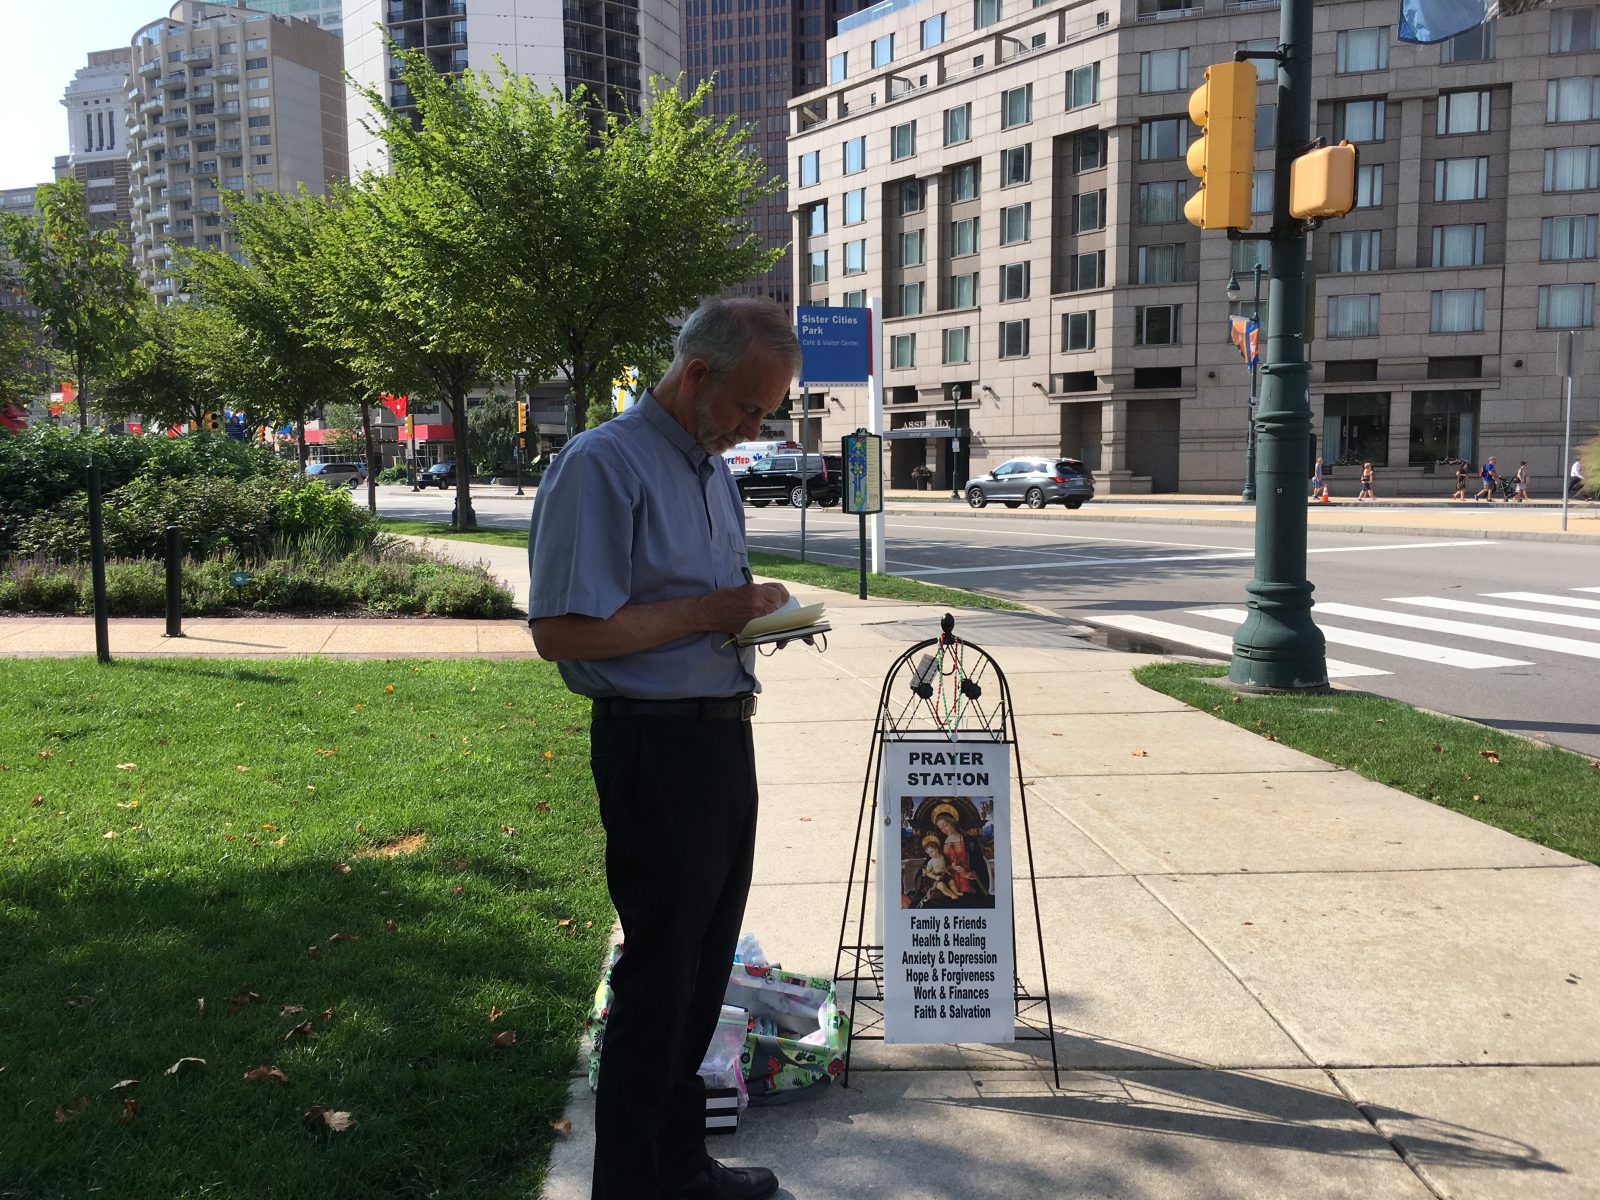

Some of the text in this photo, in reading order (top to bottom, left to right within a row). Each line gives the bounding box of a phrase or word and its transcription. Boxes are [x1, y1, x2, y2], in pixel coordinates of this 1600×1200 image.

[802, 315, 858, 324] Sister Cities
[802, 326, 823, 334] Park
[903, 419, 951, 429] ASSEBLY
[909, 752, 984, 766] PRAYER
[907, 772, 989, 786] STATION
[910, 916, 987, 932] Family & Friends
[912, 933, 986, 950] Health & Healing
[902, 951, 998, 967] Anxiety & Depression
[906, 968, 995, 985] Hope & Forgiveness
[914, 986, 989, 999] Work & Finances
[914, 1005, 991, 1018] Faith & Salvation
